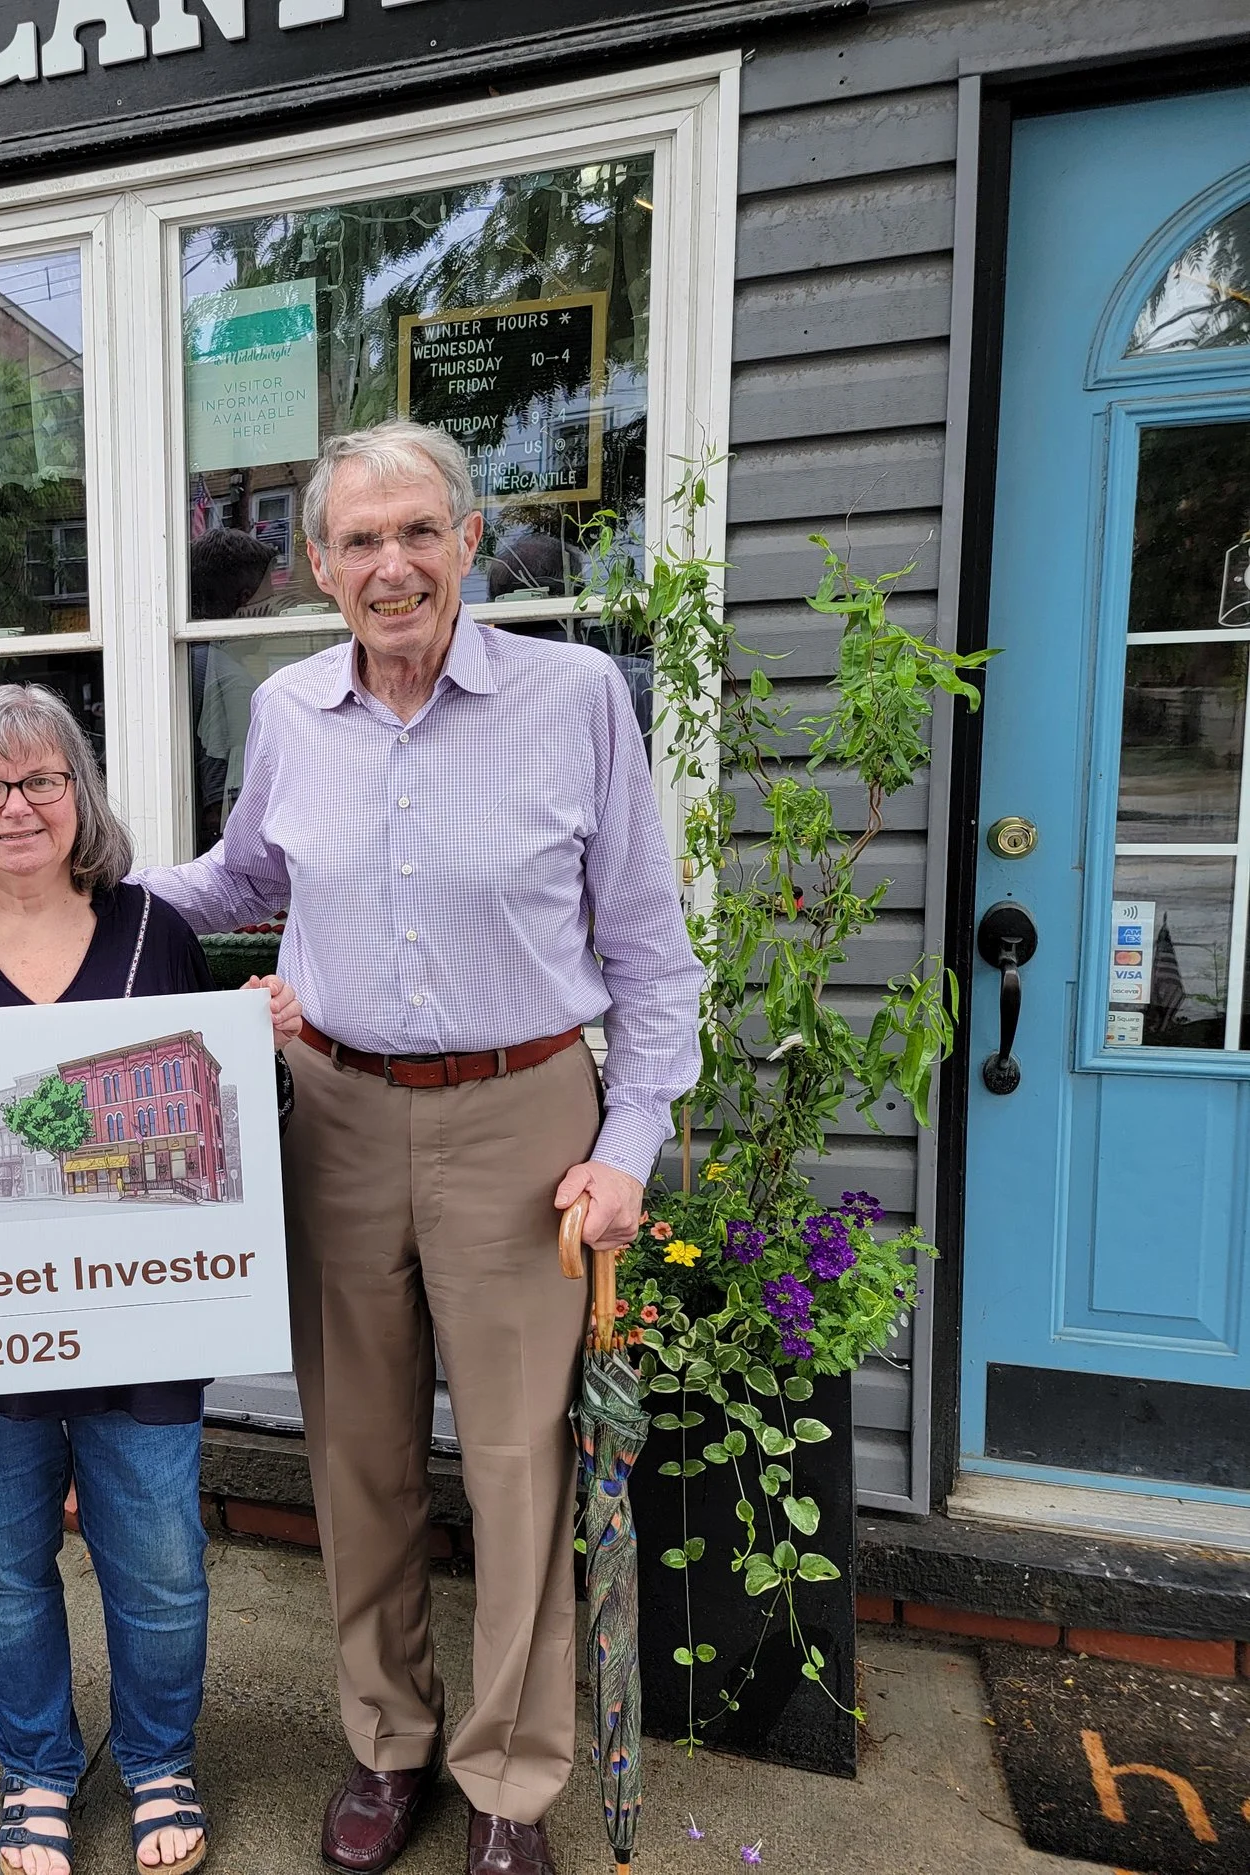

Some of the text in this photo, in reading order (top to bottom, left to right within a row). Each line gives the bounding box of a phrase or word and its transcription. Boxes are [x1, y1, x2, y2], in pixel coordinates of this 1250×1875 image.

[425, 312, 549, 341] WINTER HOURS
[225, 346, 291, 366] Middleburgh!
[413, 337, 495, 360] WEDNESDAY
[430, 356, 504, 378] THURSDAY
[224, 377, 283, 394] VISITOR
[448, 376, 498, 395] FRIDAY
[201, 389, 306, 412] INFORMATION
[213, 406, 295, 425] AVAILABLE
[428, 415, 499, 433] SATURDAY
[232, 423, 275, 438] HERE!
[524, 440, 542, 454] US
[492, 470, 577, 490] MERCANTILE
[1115, 970, 1142, 979] VISA
[1116, 1015, 1140, 1023] Square
[73, 1250, 256, 1291] Investor
